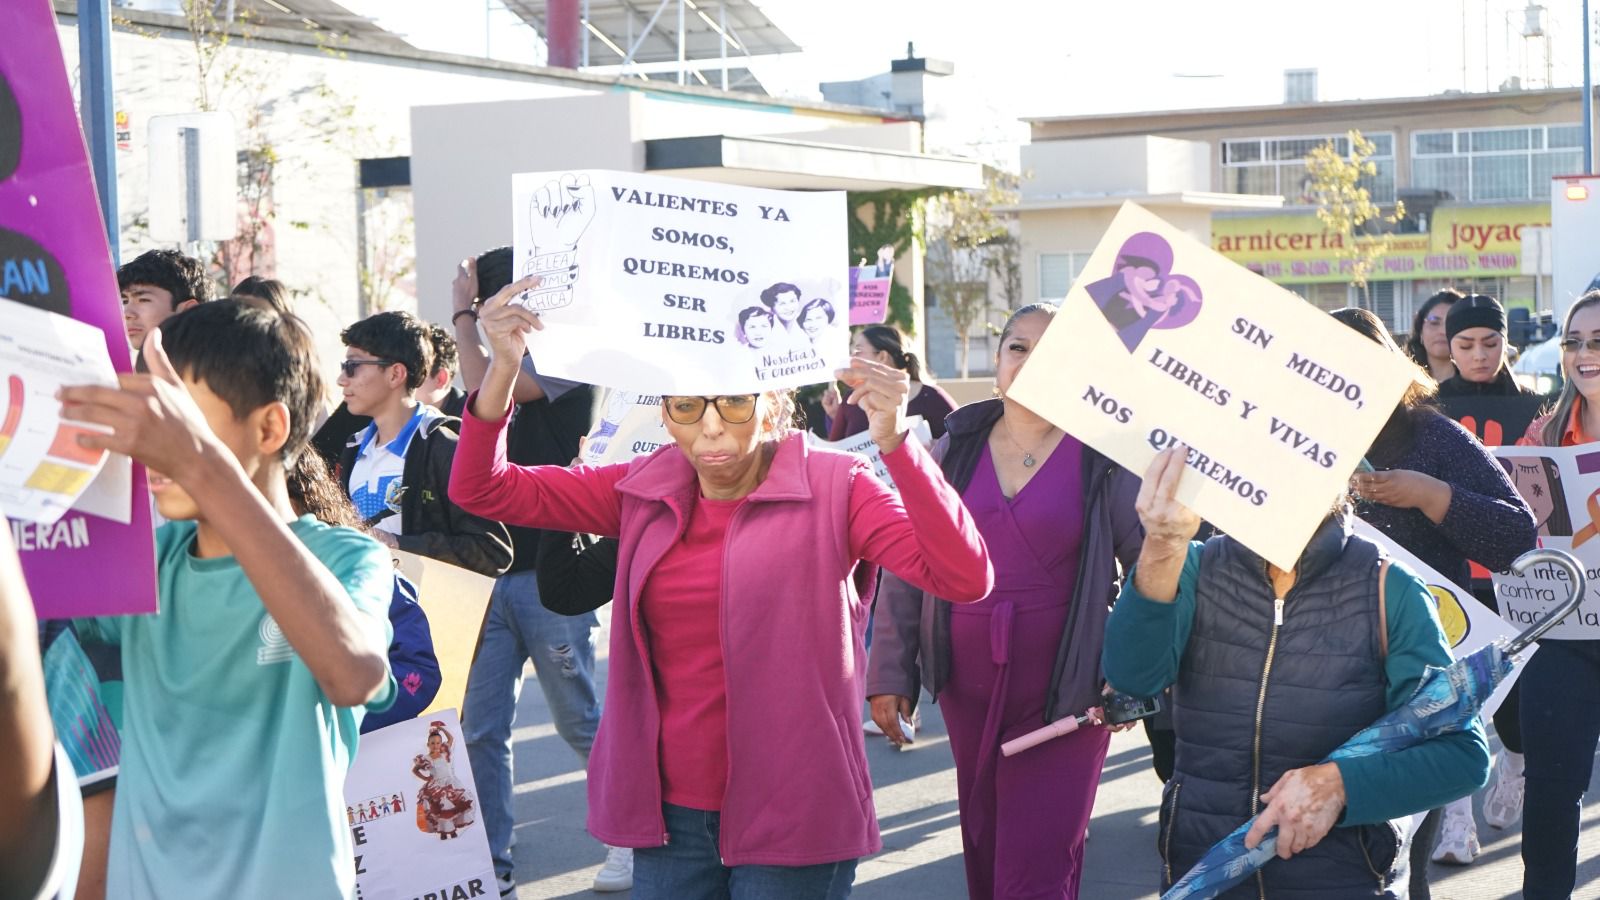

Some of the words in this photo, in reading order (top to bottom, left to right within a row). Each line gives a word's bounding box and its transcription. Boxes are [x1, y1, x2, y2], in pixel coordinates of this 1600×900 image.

[611, 186, 738, 217] VALIENTES
[757, 205, 790, 222] YA
[651, 226, 735, 254] SOMOS,
[1212, 228, 1344, 251] arnicería
[527, 254, 569, 273] PELEA
[623, 257, 750, 285] QUEREMOS
[0, 258, 50, 296] AN
[539, 273, 569, 288] OMO
[527, 291, 566, 309] CHICA
[663, 293, 707, 313] SER
[643, 322, 725, 344] LIBRES
[1231, 317, 1275, 350] SIN
[1285, 352, 1364, 410] MIEDO,
[636, 394, 662, 406] LIBR
[1082, 385, 1133, 424] NOS
[1148, 348, 1231, 406] LIBRES
[1239, 400, 1258, 419] Y
[1268, 416, 1338, 469] VIVAS
[631, 441, 664, 453] QUE
[846, 440, 877, 453] UCHO
[1500, 580, 1556, 601] contra
[1506, 600, 1566, 626] hac
[1577, 607, 1600, 627] la
